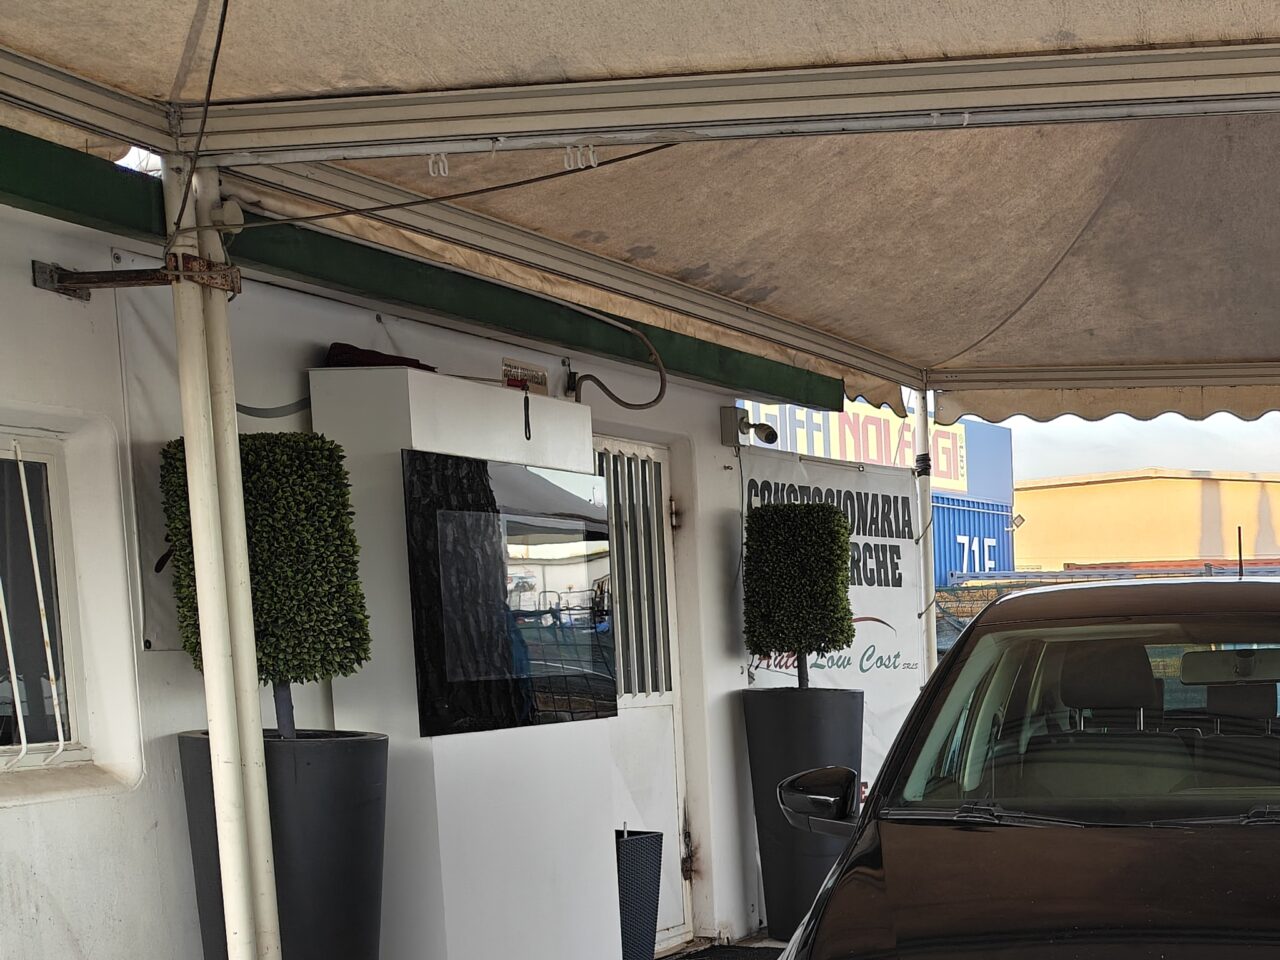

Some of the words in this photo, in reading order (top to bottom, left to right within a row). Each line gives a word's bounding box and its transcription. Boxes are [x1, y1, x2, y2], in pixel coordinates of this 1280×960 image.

[838, 411, 960, 480] NOLEGI
[810, 650, 852, 671] Low
[859, 644, 901, 673] Cost
